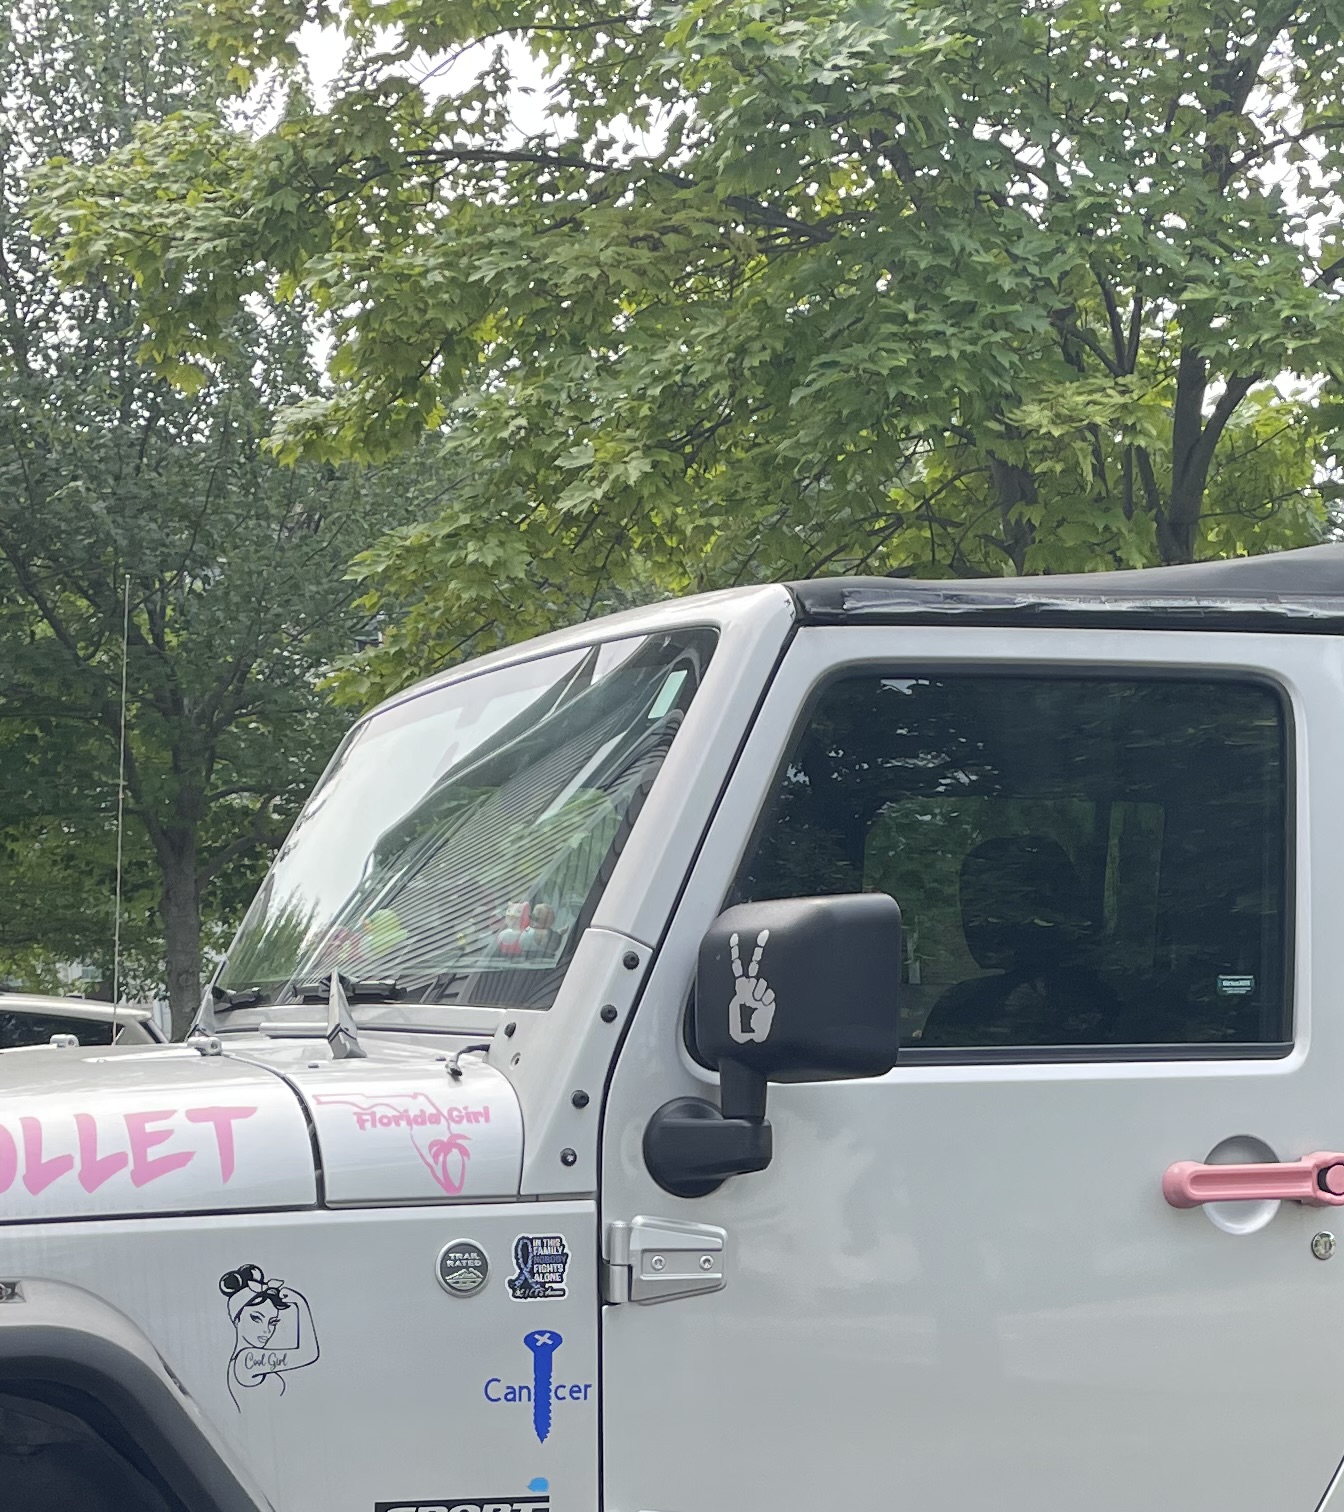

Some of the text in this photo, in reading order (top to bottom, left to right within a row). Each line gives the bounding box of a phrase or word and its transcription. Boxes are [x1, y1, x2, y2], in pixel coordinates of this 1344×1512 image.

[353, 1105, 490, 1131] Florida Girl
[532, 1238, 561, 1247] IN THIS
[533, 1246, 563, 1256] FAMILY
[449, 1252, 480, 1260] TRAIL
[533, 1255, 567, 1264] NOBODY
[446, 1259, 482, 1268] RATED
[533, 1263, 564, 1273] FIGHTS
[533, 1273, 562, 1282] ALONE
